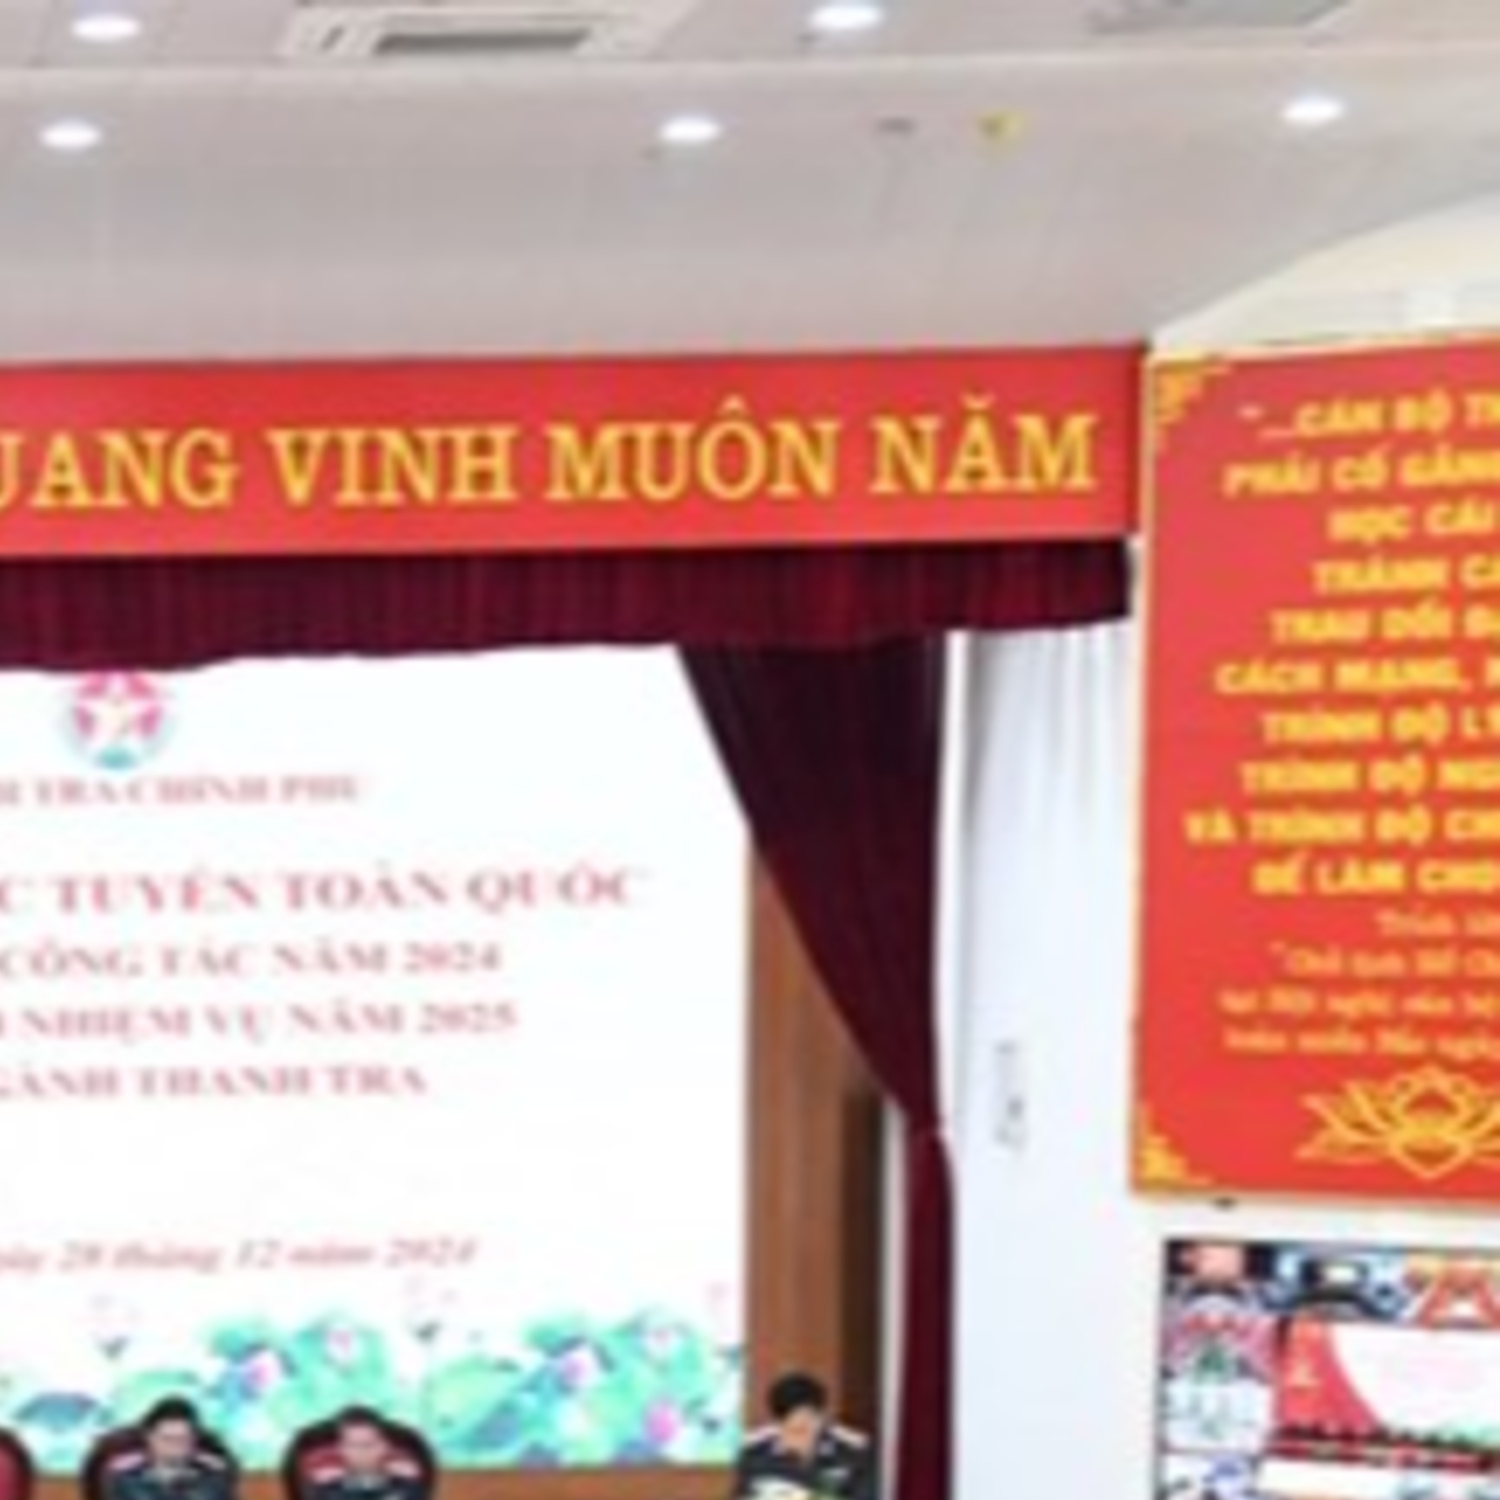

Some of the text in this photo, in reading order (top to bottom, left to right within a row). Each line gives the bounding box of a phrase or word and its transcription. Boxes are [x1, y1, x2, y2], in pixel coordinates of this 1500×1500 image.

[267, 425, 517, 505] VINH
[546, 397, 840, 500] MUÔN
[870, 395, 1095, 493] NĂM
[35, 774, 118, 806] TRA
[281, 860, 450, 911] TOÀN
[272, 934, 390, 975] NĂM
[401, 941, 504, 974] 2024
[287, 996, 405, 1036] NĂM
[417, 1001, 519, 1036] 2025
[135, 1065, 313, 1099] THANH
[325, 1064, 429, 1097] TRA
